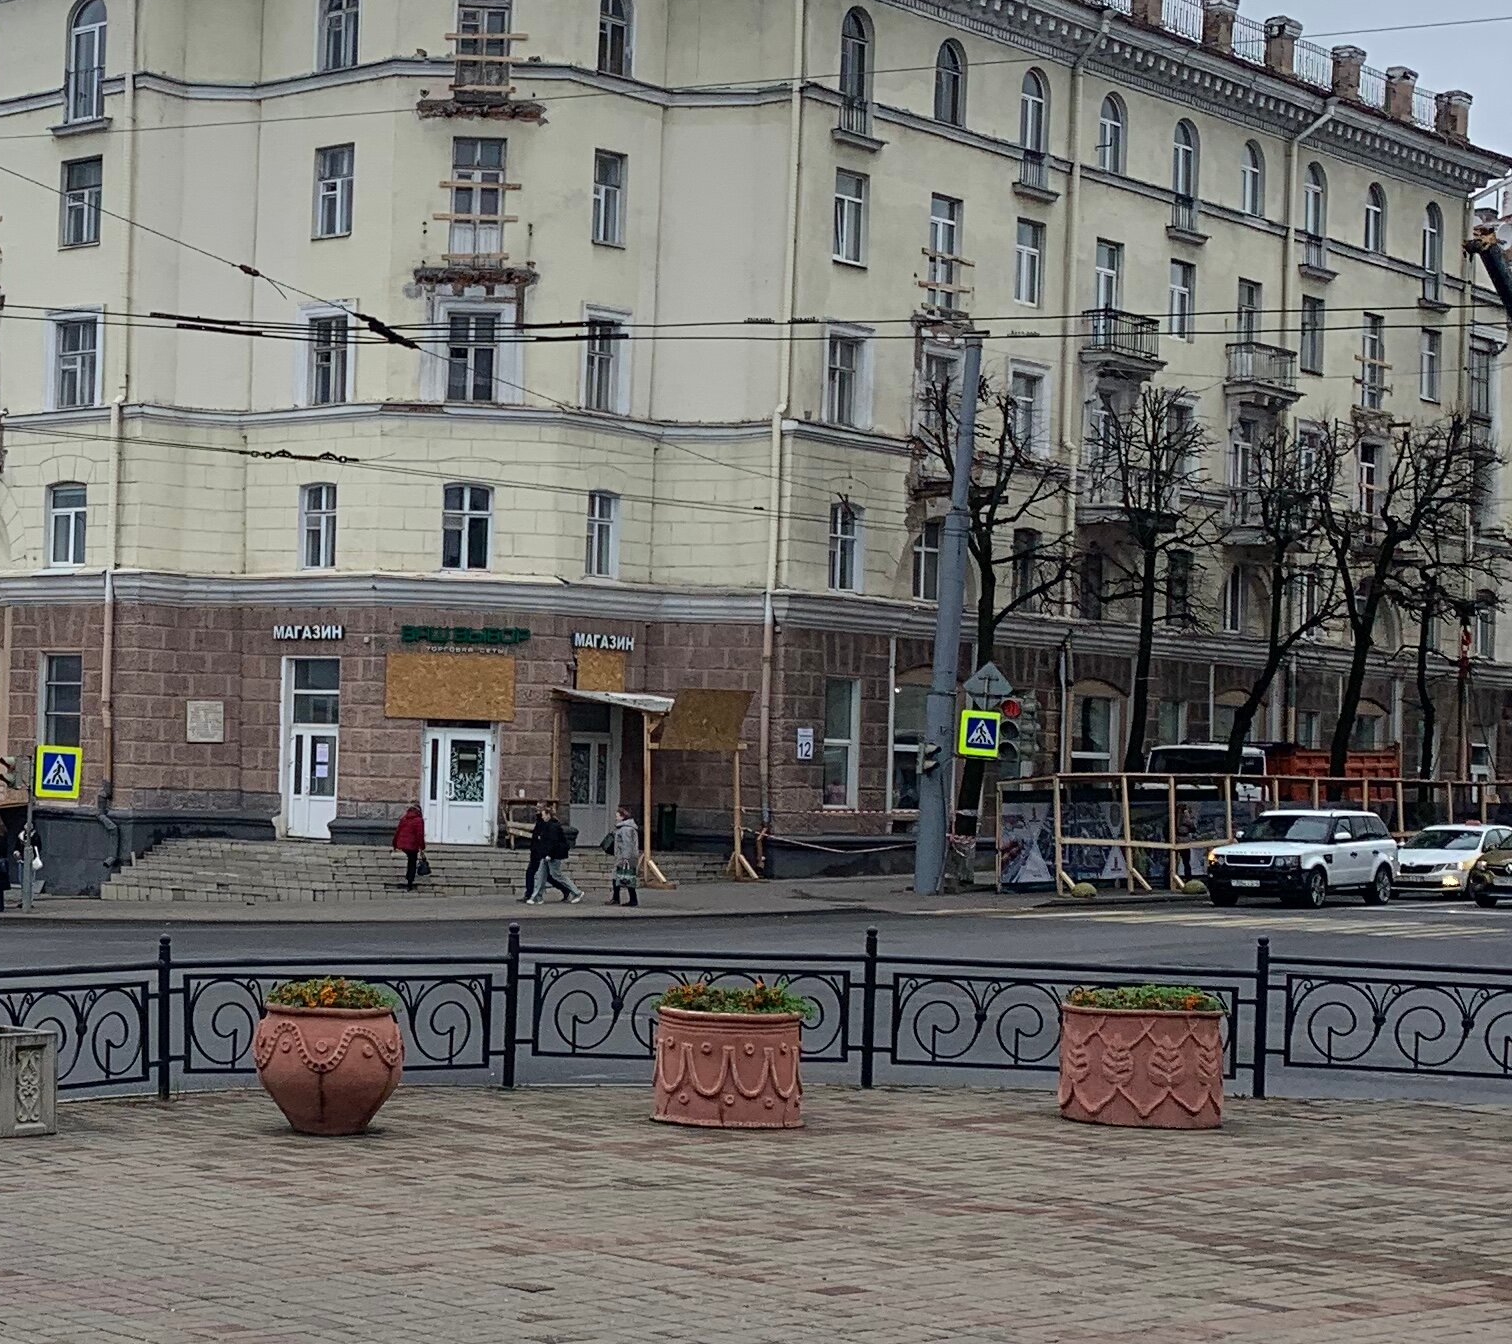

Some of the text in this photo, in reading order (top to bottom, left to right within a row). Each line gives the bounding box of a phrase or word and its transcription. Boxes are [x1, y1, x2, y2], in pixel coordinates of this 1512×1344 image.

[273, 625, 343, 640] МАГАЗИН
[453, 626, 531, 645] ВЫБОР
[574, 632, 635, 651] МАГАЗИН
[798, 741, 811, 758] 12
